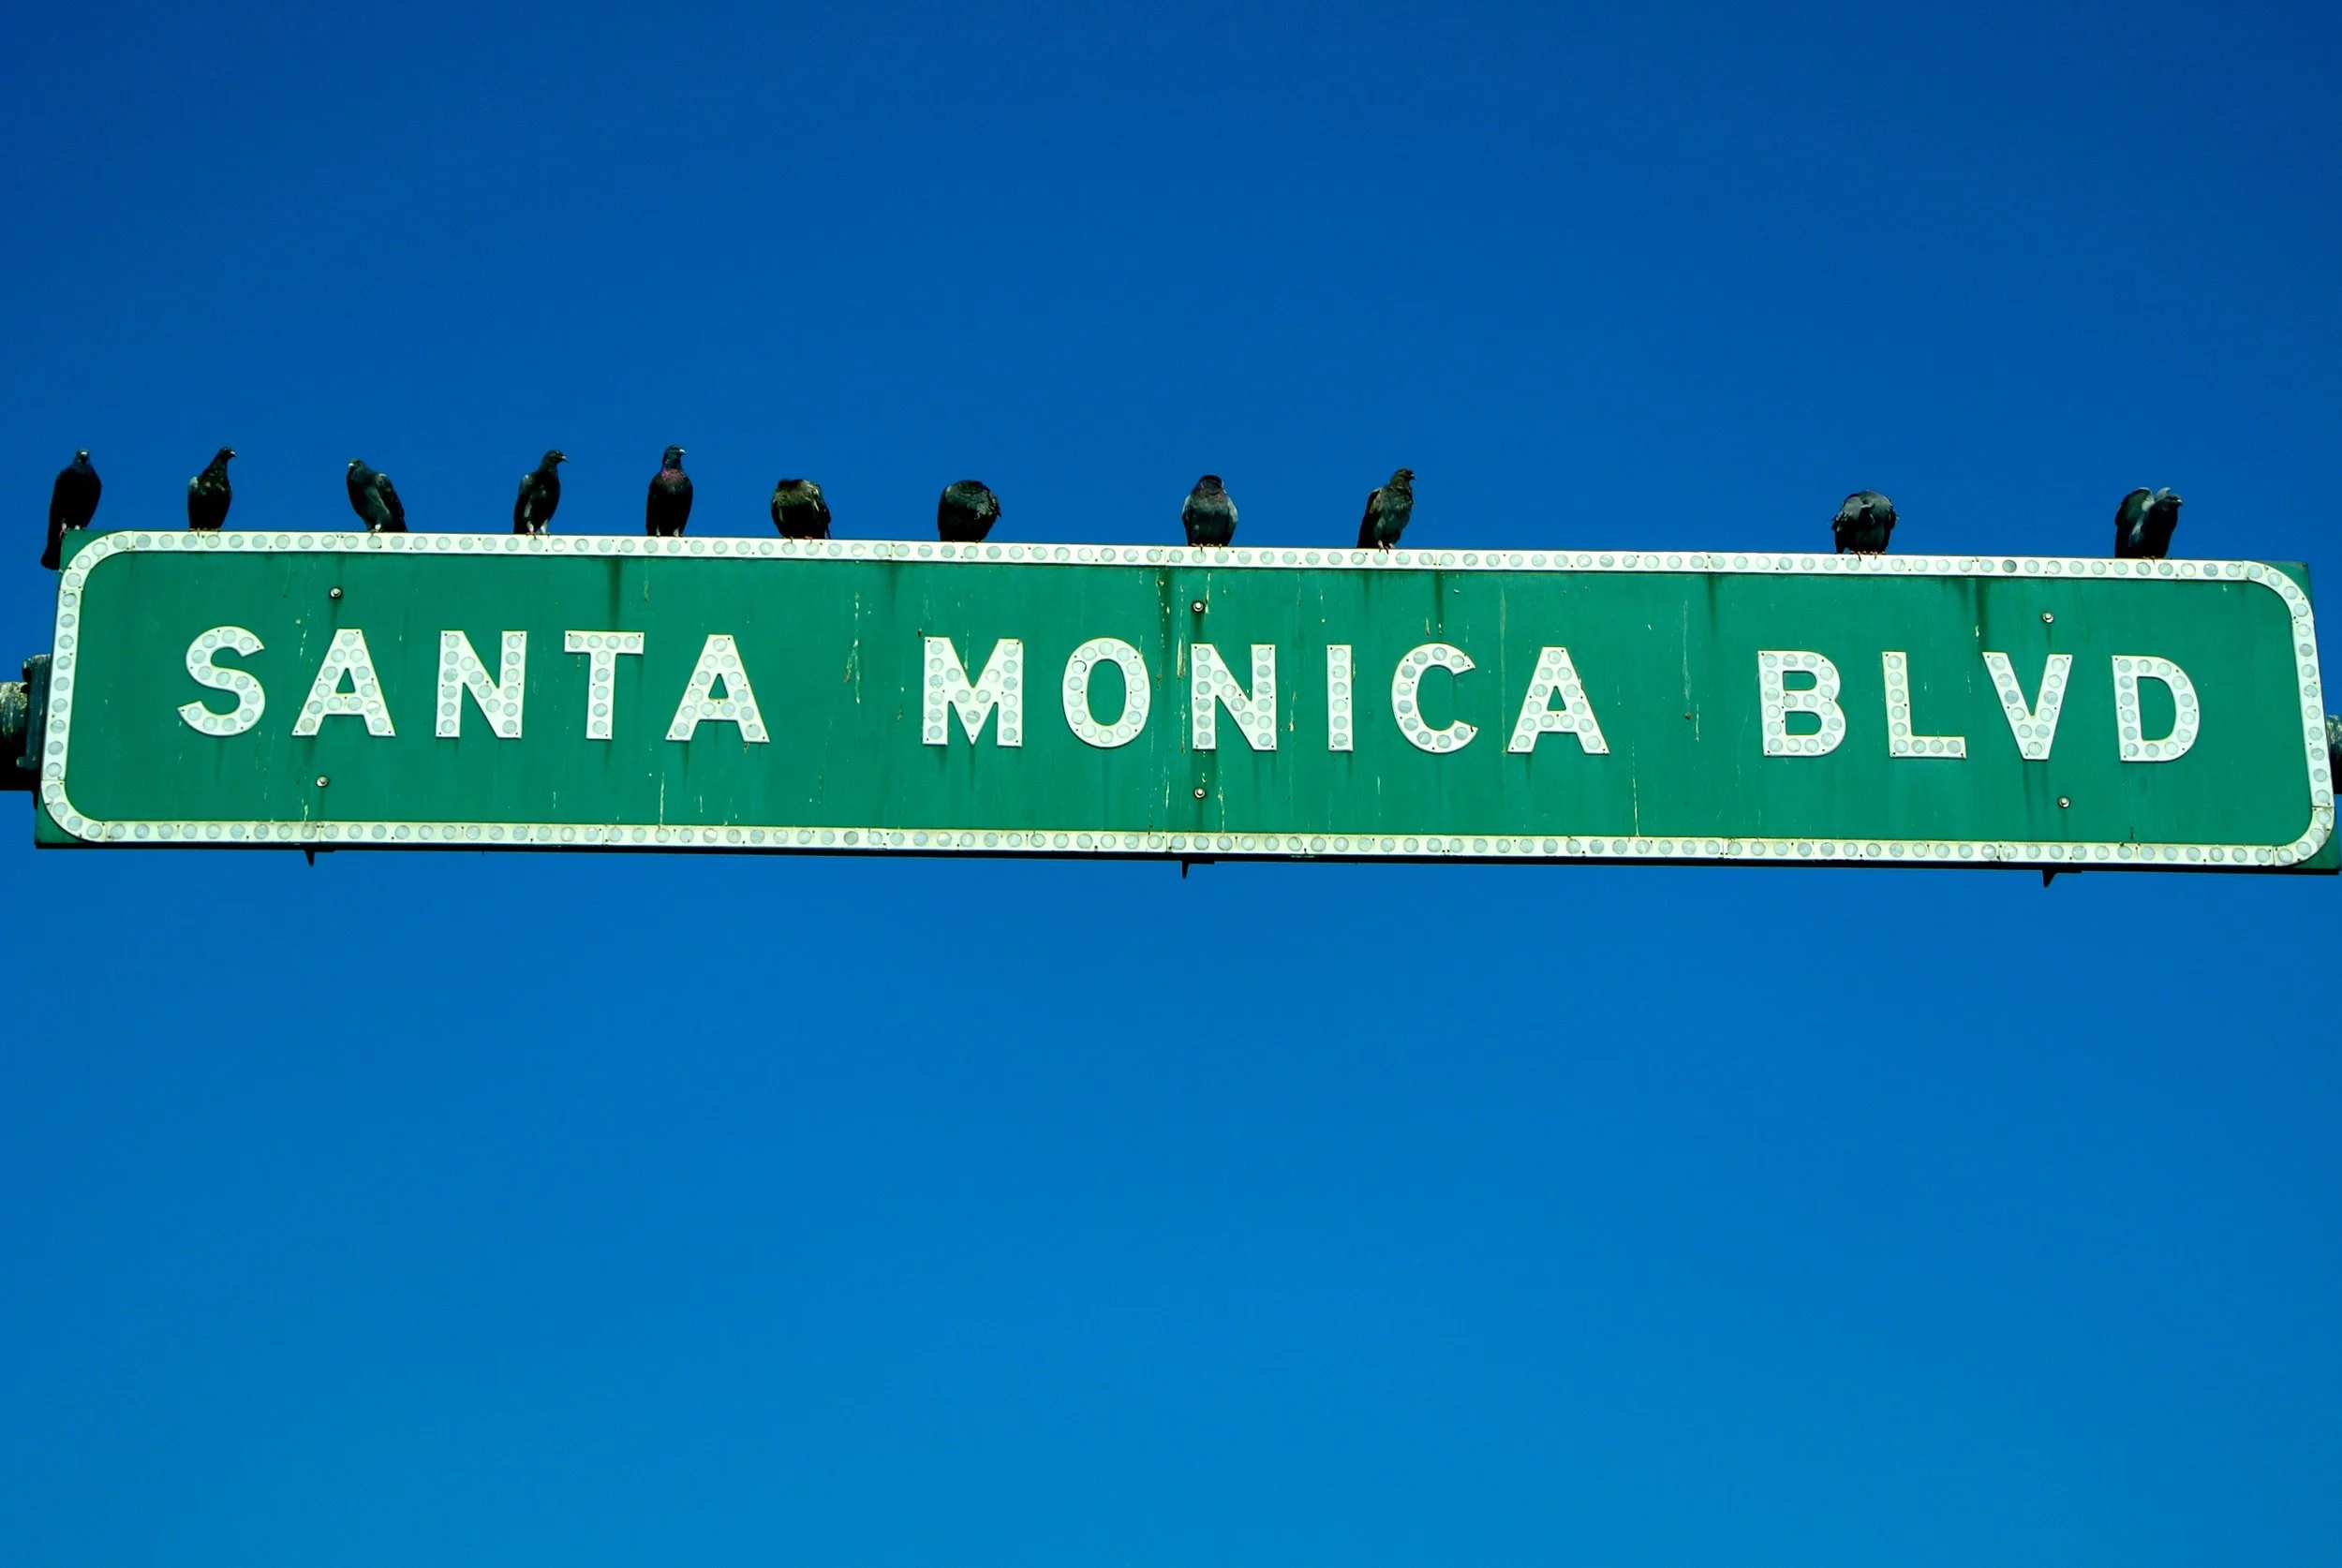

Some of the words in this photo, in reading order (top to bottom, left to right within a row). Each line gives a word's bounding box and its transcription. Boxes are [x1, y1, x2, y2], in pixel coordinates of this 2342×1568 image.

[178, 626, 771, 744] SANTA
[921, 635, 1610, 755] MONICA
[1756, 649, 2201, 762] BLVD
